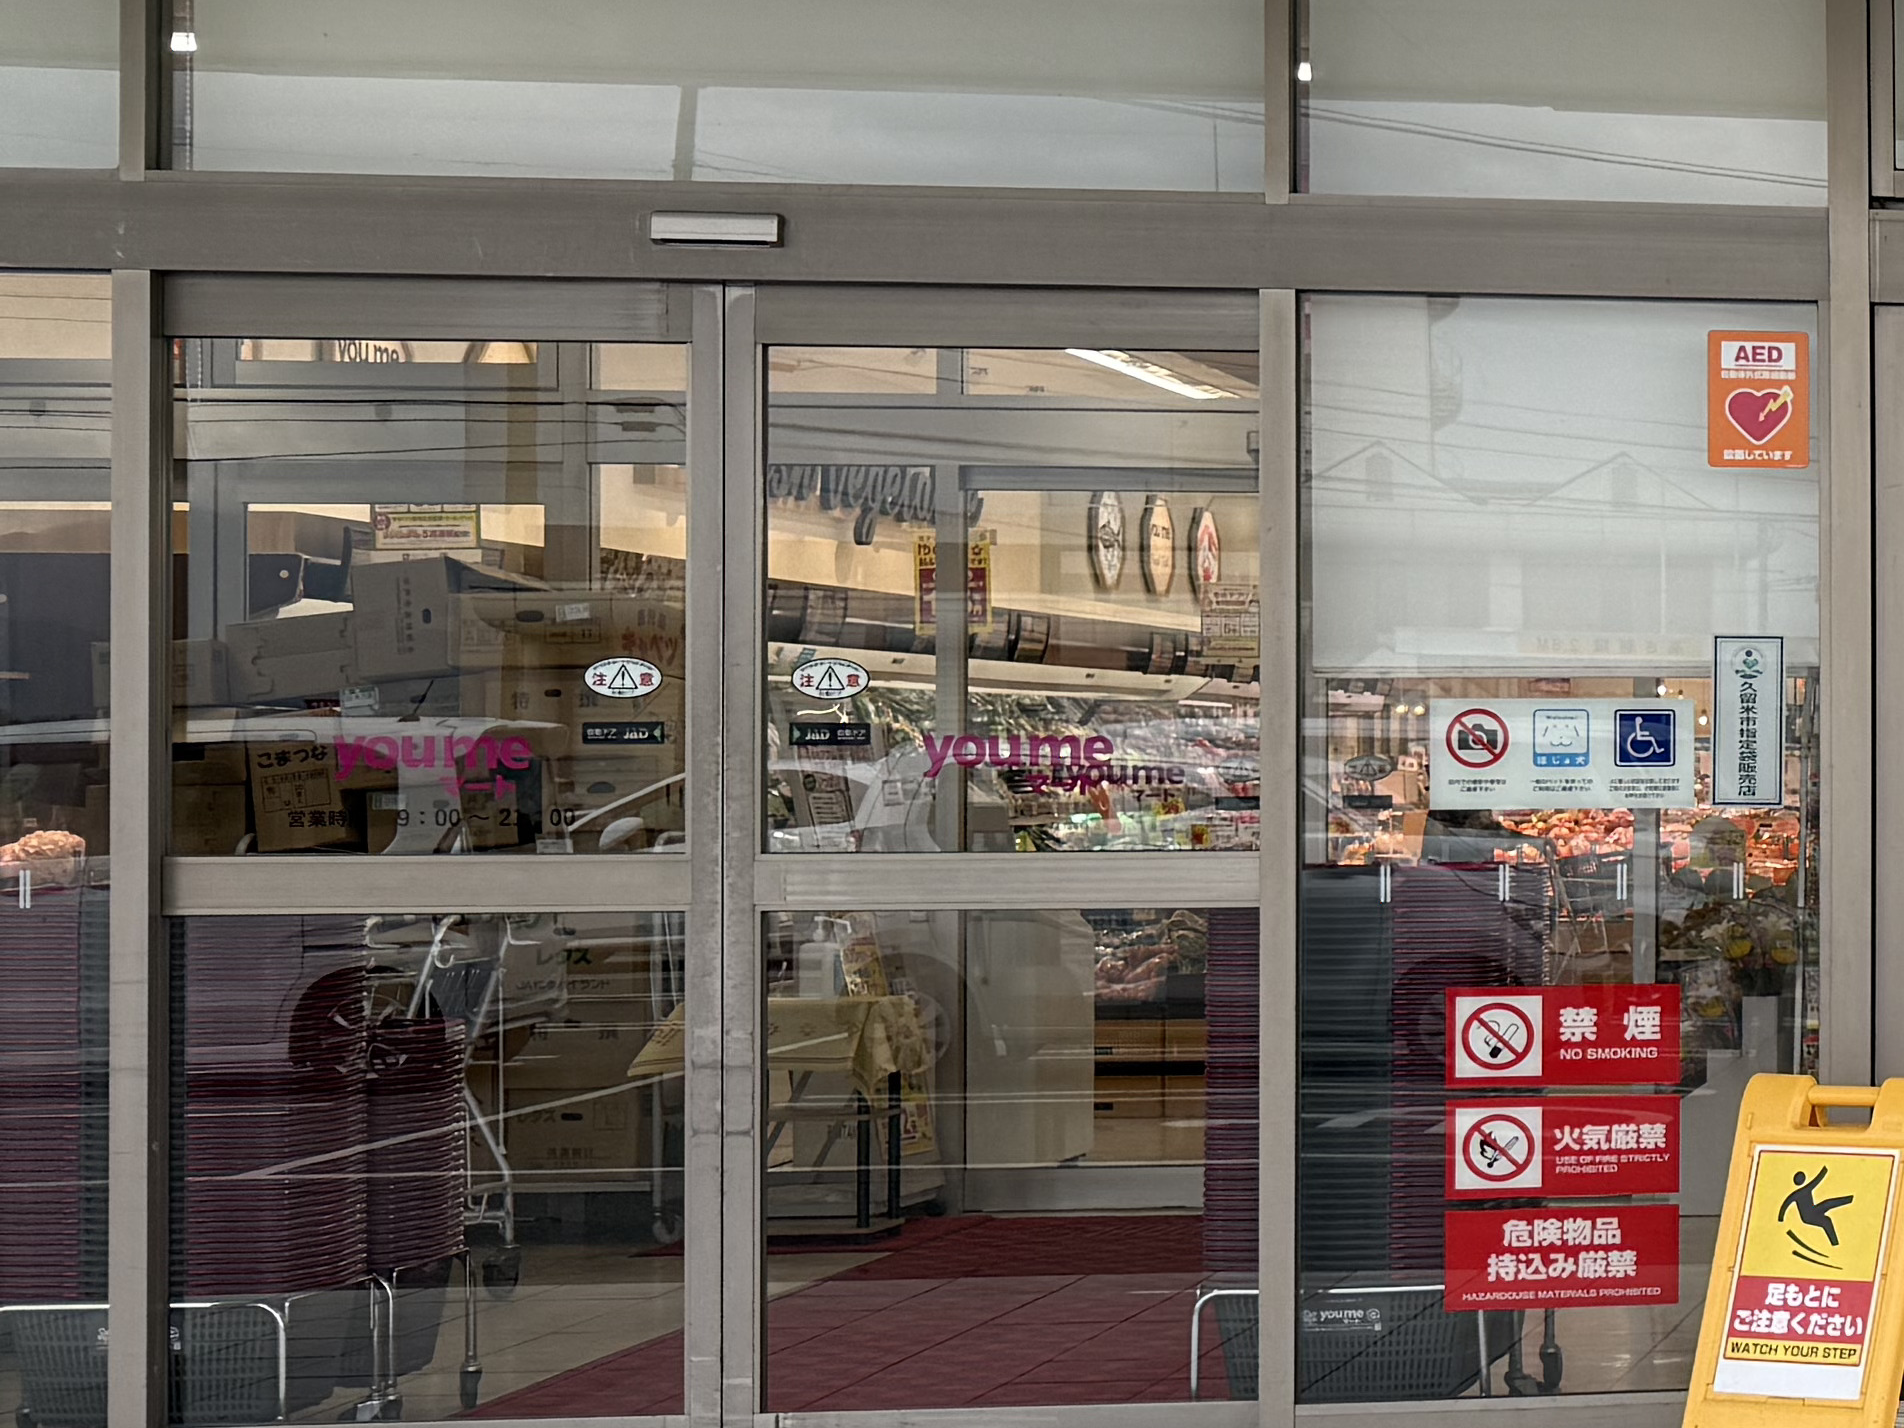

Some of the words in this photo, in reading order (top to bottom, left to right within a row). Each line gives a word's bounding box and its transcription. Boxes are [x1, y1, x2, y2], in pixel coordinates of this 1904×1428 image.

[1735, 345, 1783, 363] AED
[1737, 680, 1758, 797] 久留米市指定袋販売店
[257, 745, 328, 769] こまつな
[287, 809, 362, 828] 営業時
[1559, 1005, 1662, 1042] 禁煙
[1559, 1048, 1583, 1060] NO
[1587, 1047, 1658, 1060] SMOKING
[1553, 1123, 1666, 1150] 火気厳禁
[1556, 1156, 1578, 1164] USE
[1580, 1156, 1594, 1164] OF
[1596, 1155, 1618, 1163] FIRE
[1620, 1154, 1670, 1162] STRICTLY
[1556, 1165, 1618, 1174] PROHIBITED
[1503, 1217, 1622, 1247] 危険物品
[1487, 1250, 1637, 1282] 持込み厳禁
[1538, 1289, 1598, 1299] MATERIALS
[1599, 1287, 1661, 1297] PROHIBITED
[1765, 1283, 1842, 1308] 足もとに
[1733, 1309, 1863, 1337] ご注意ください
[1731, 1342, 1779, 1356] WATCH
[1783, 1345, 1819, 1358] YOUR
[1822, 1347, 1857, 1360] STEP
